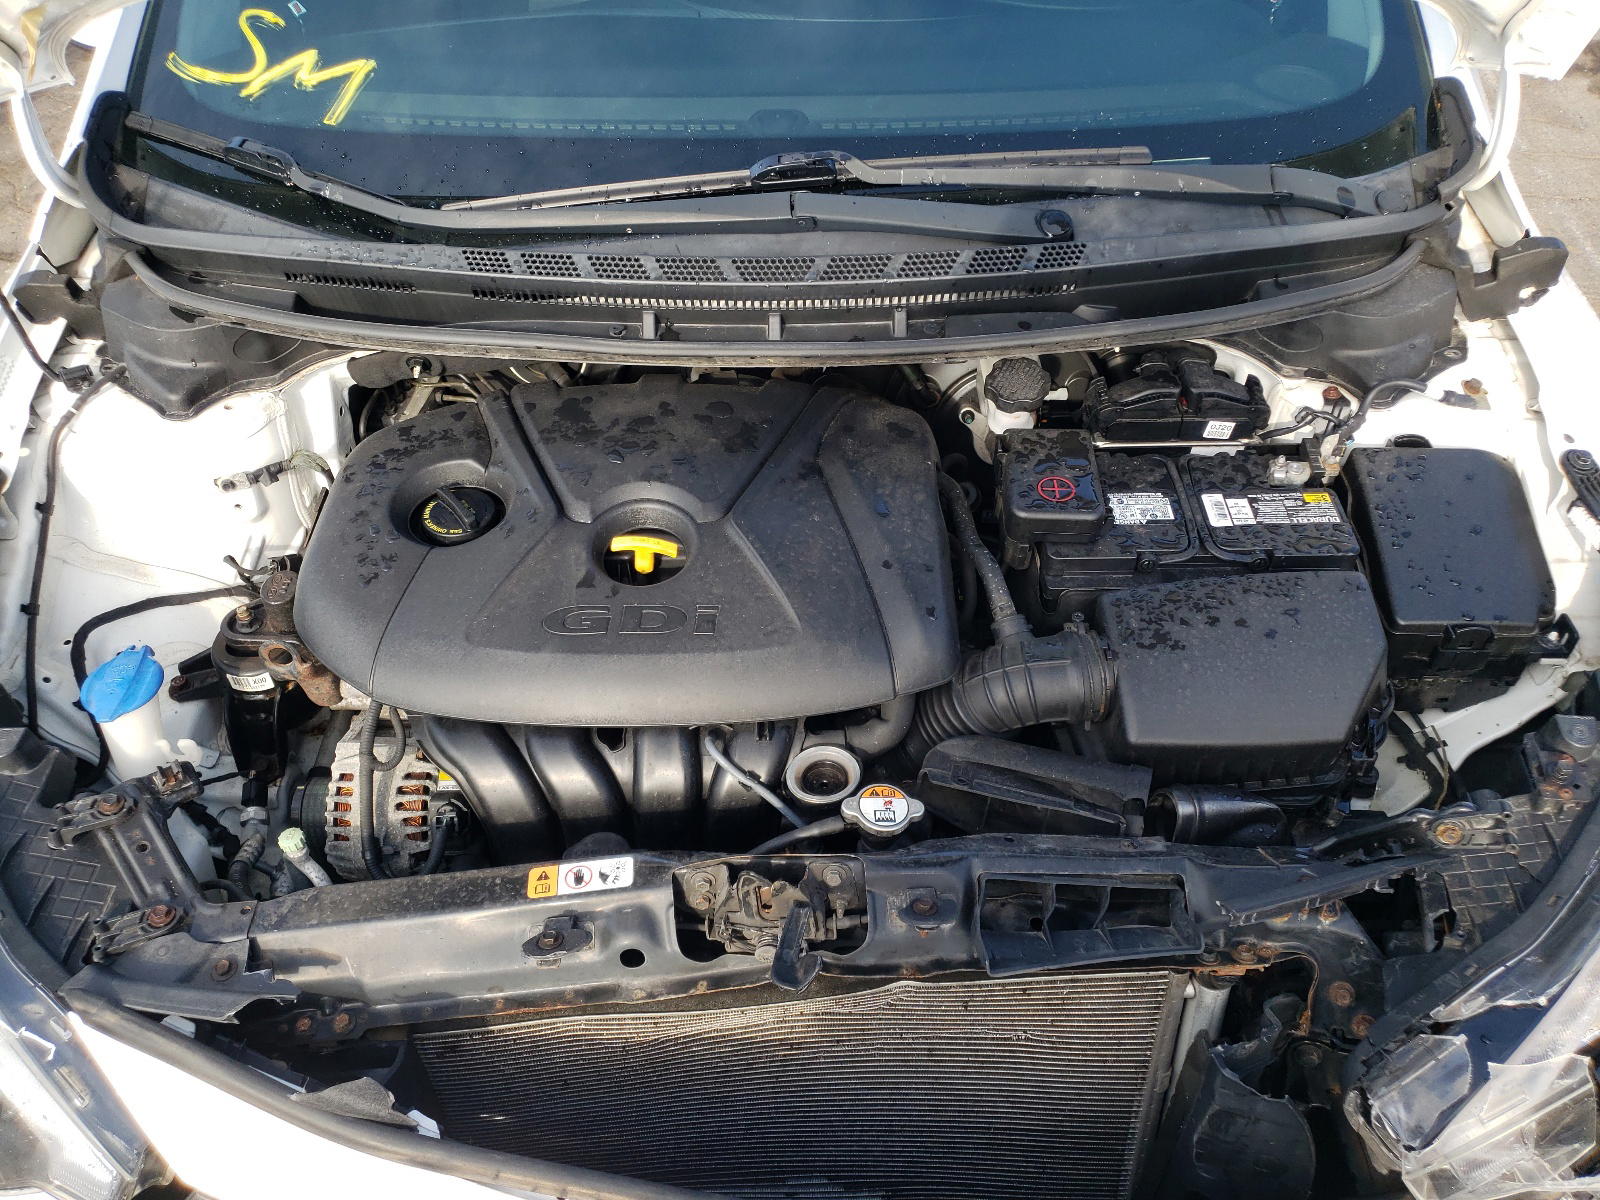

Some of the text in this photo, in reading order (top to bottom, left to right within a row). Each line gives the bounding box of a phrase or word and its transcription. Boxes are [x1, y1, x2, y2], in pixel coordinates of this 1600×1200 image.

[164, 8, 378, 126] SM
[1290, 516, 1341, 524] DURACELL
[541, 604, 722, 635] GDi
